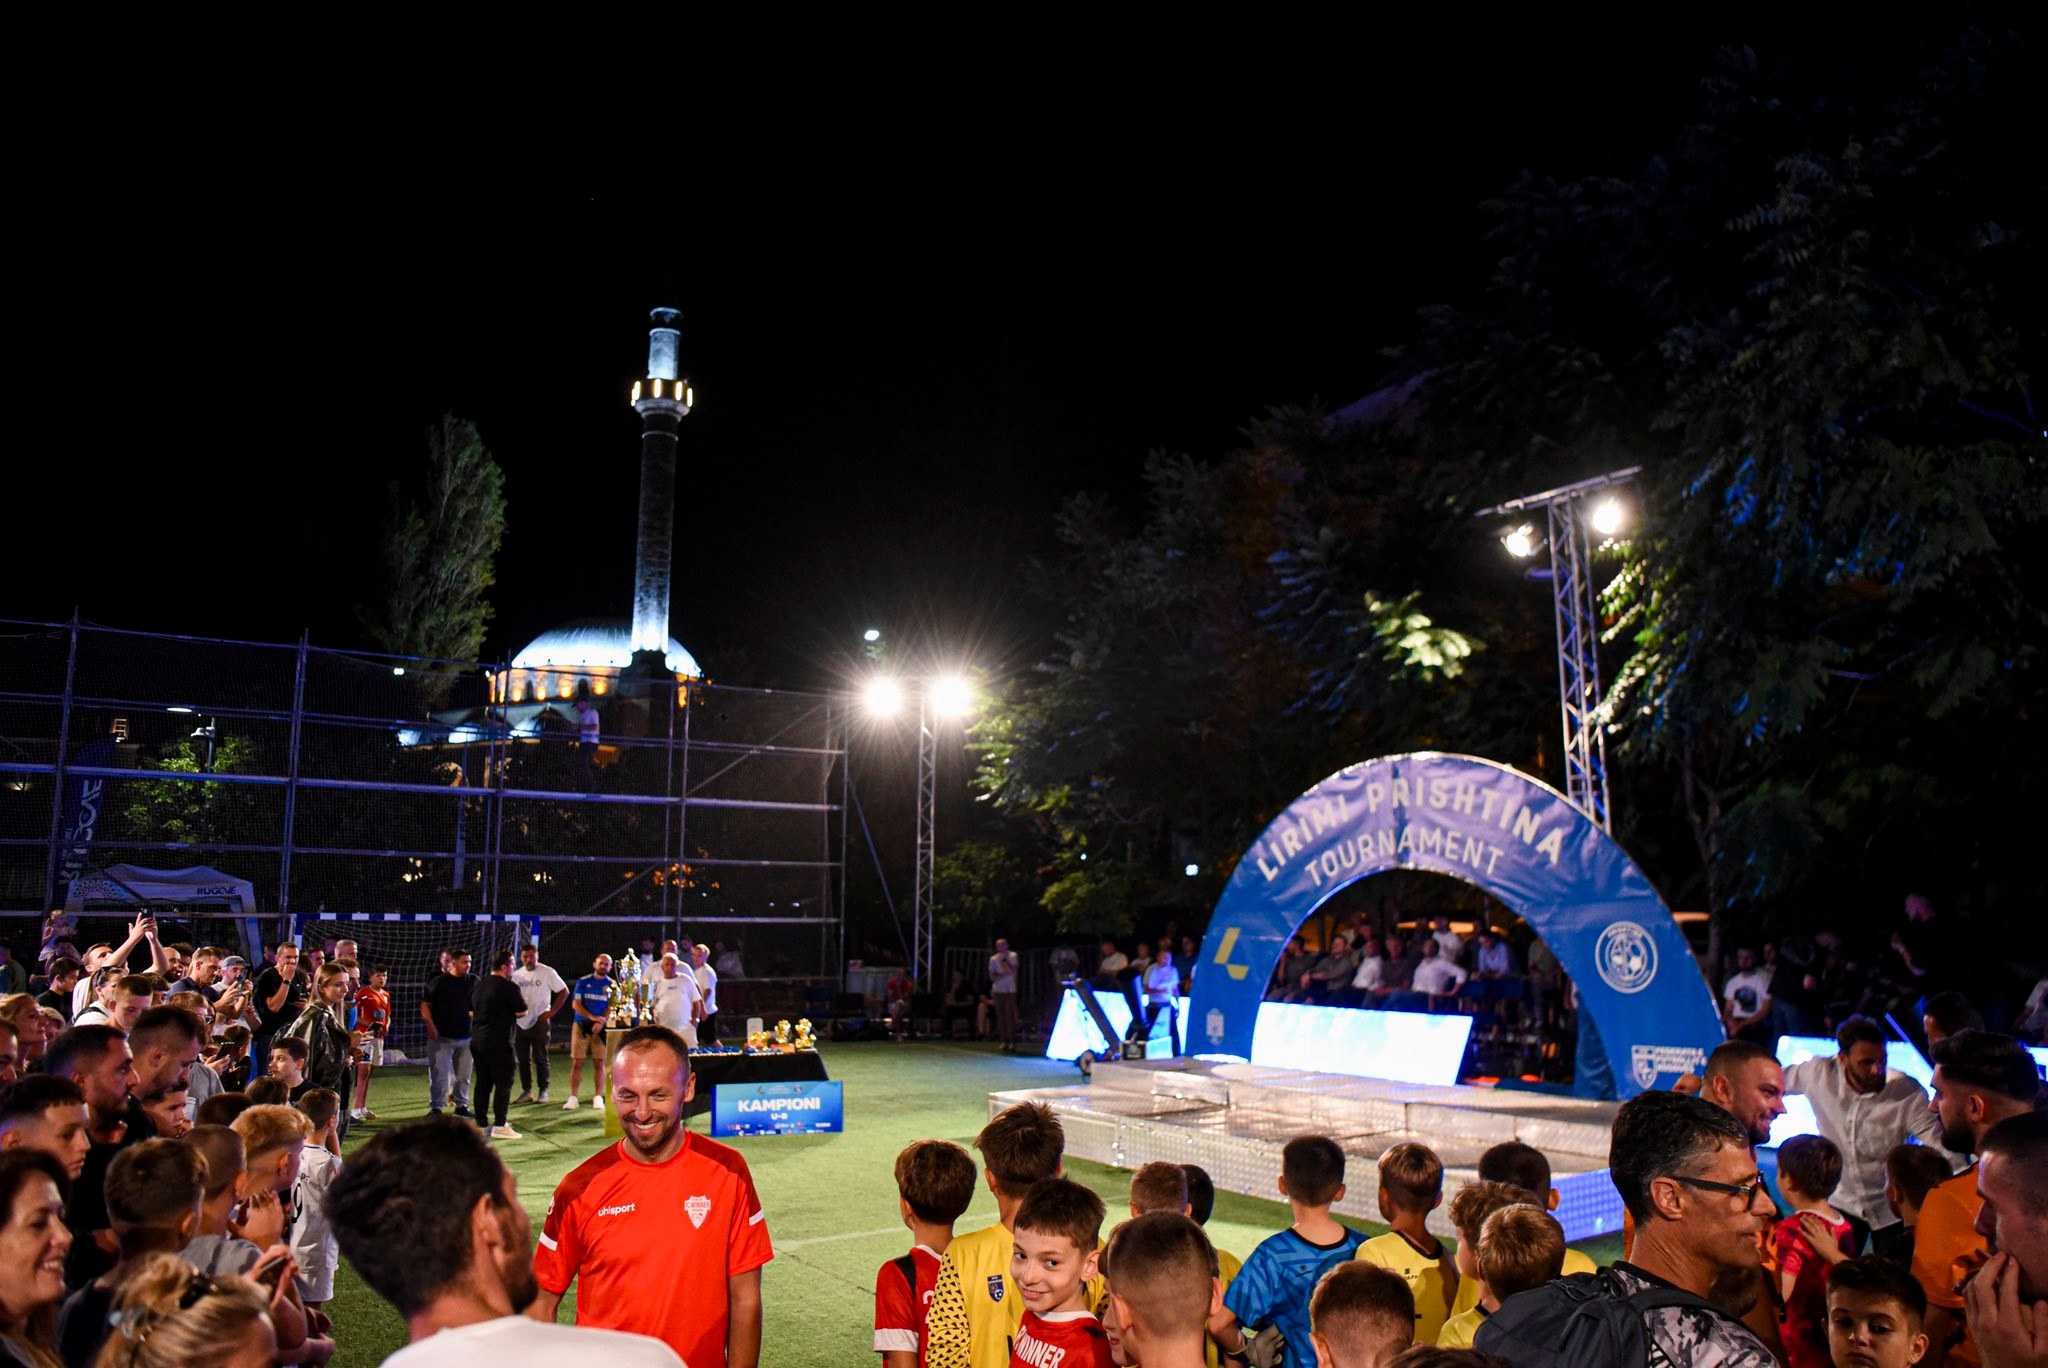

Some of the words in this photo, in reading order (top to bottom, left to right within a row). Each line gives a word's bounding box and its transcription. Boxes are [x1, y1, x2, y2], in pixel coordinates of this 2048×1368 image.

[1257, 794, 1348, 882] LIRIMI
[1366, 777, 1564, 866] PRISHTINA
[1304, 823, 1505, 887] TOURNAMENT
[738, 1097, 821, 1113] KAMPIONI
[598, 1203, 635, 1217] uhlsport
